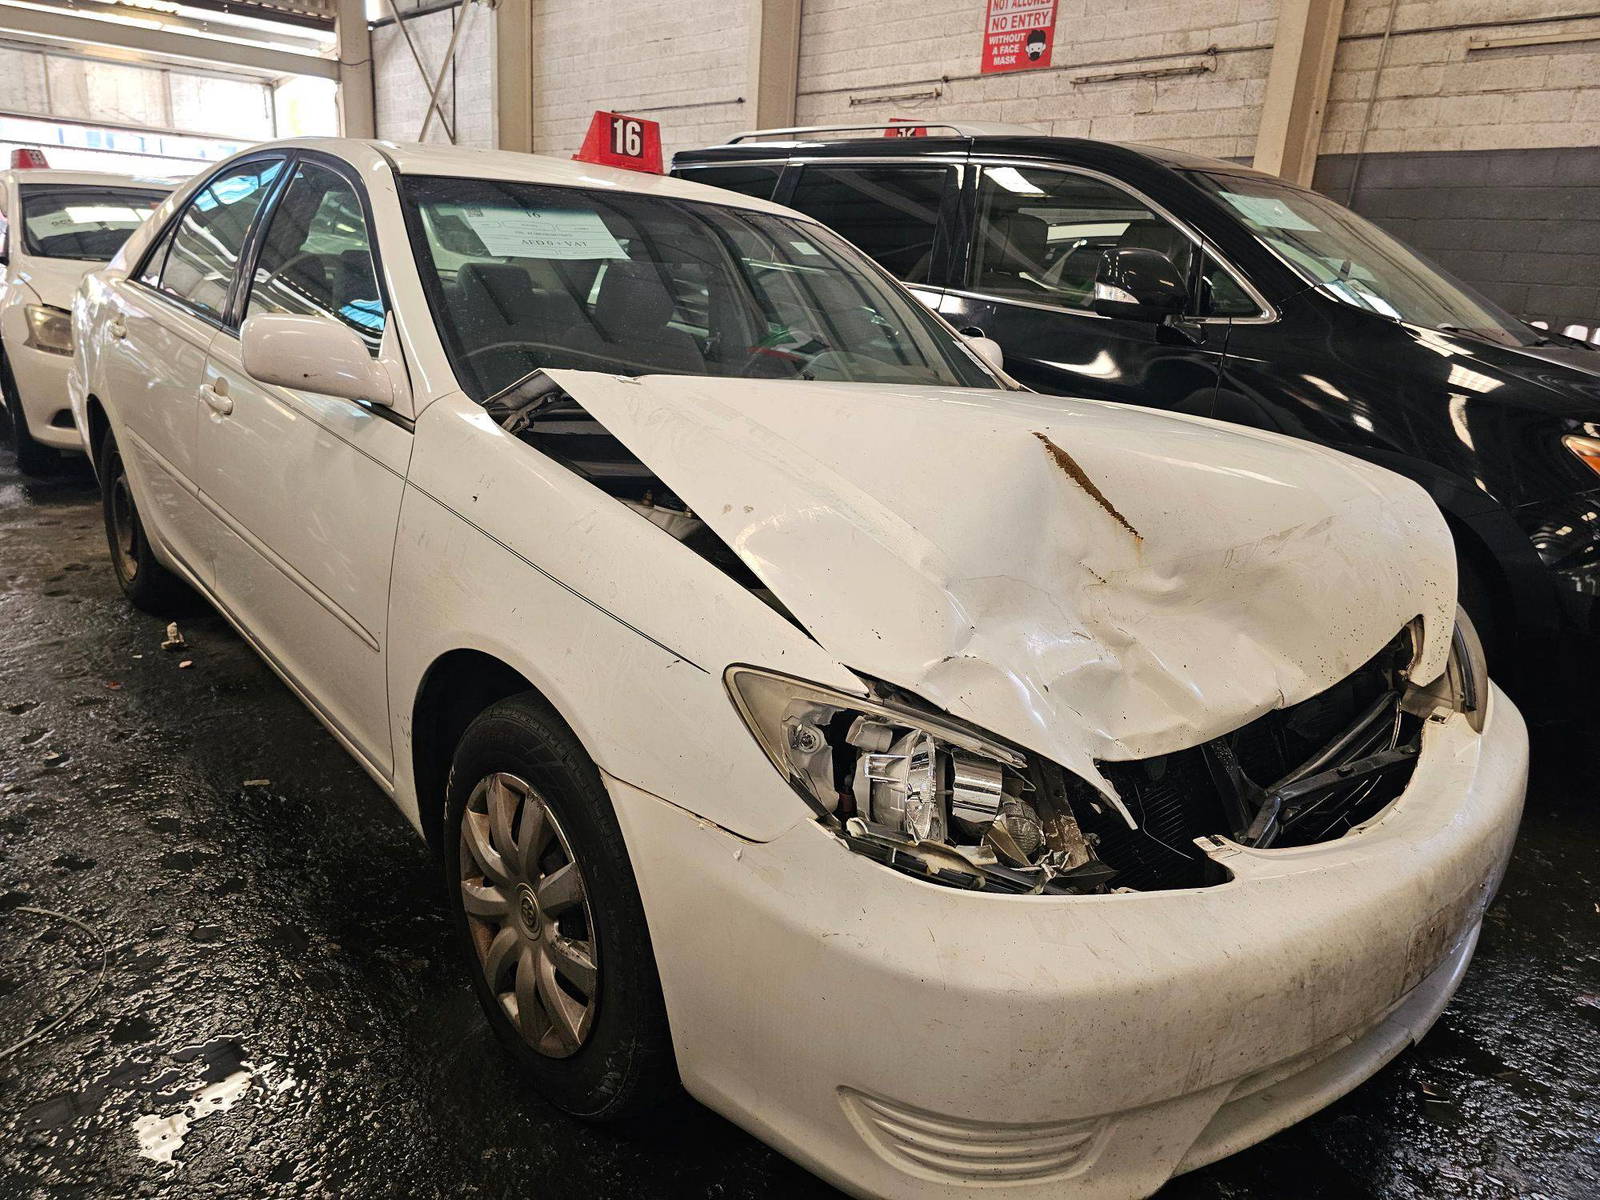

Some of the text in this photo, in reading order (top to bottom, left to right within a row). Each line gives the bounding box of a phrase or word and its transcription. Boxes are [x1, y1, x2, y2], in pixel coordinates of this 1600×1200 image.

[992, 0, 1051, 11] NOT ALLO
[992, 11, 1050, 31] NO ENTRY
[989, 33, 1026, 45] WITHOUT
[992, 44, 1020, 55] A FACE
[993, 56, 1016, 65] MASK
[613, 118, 641, 156] 16
